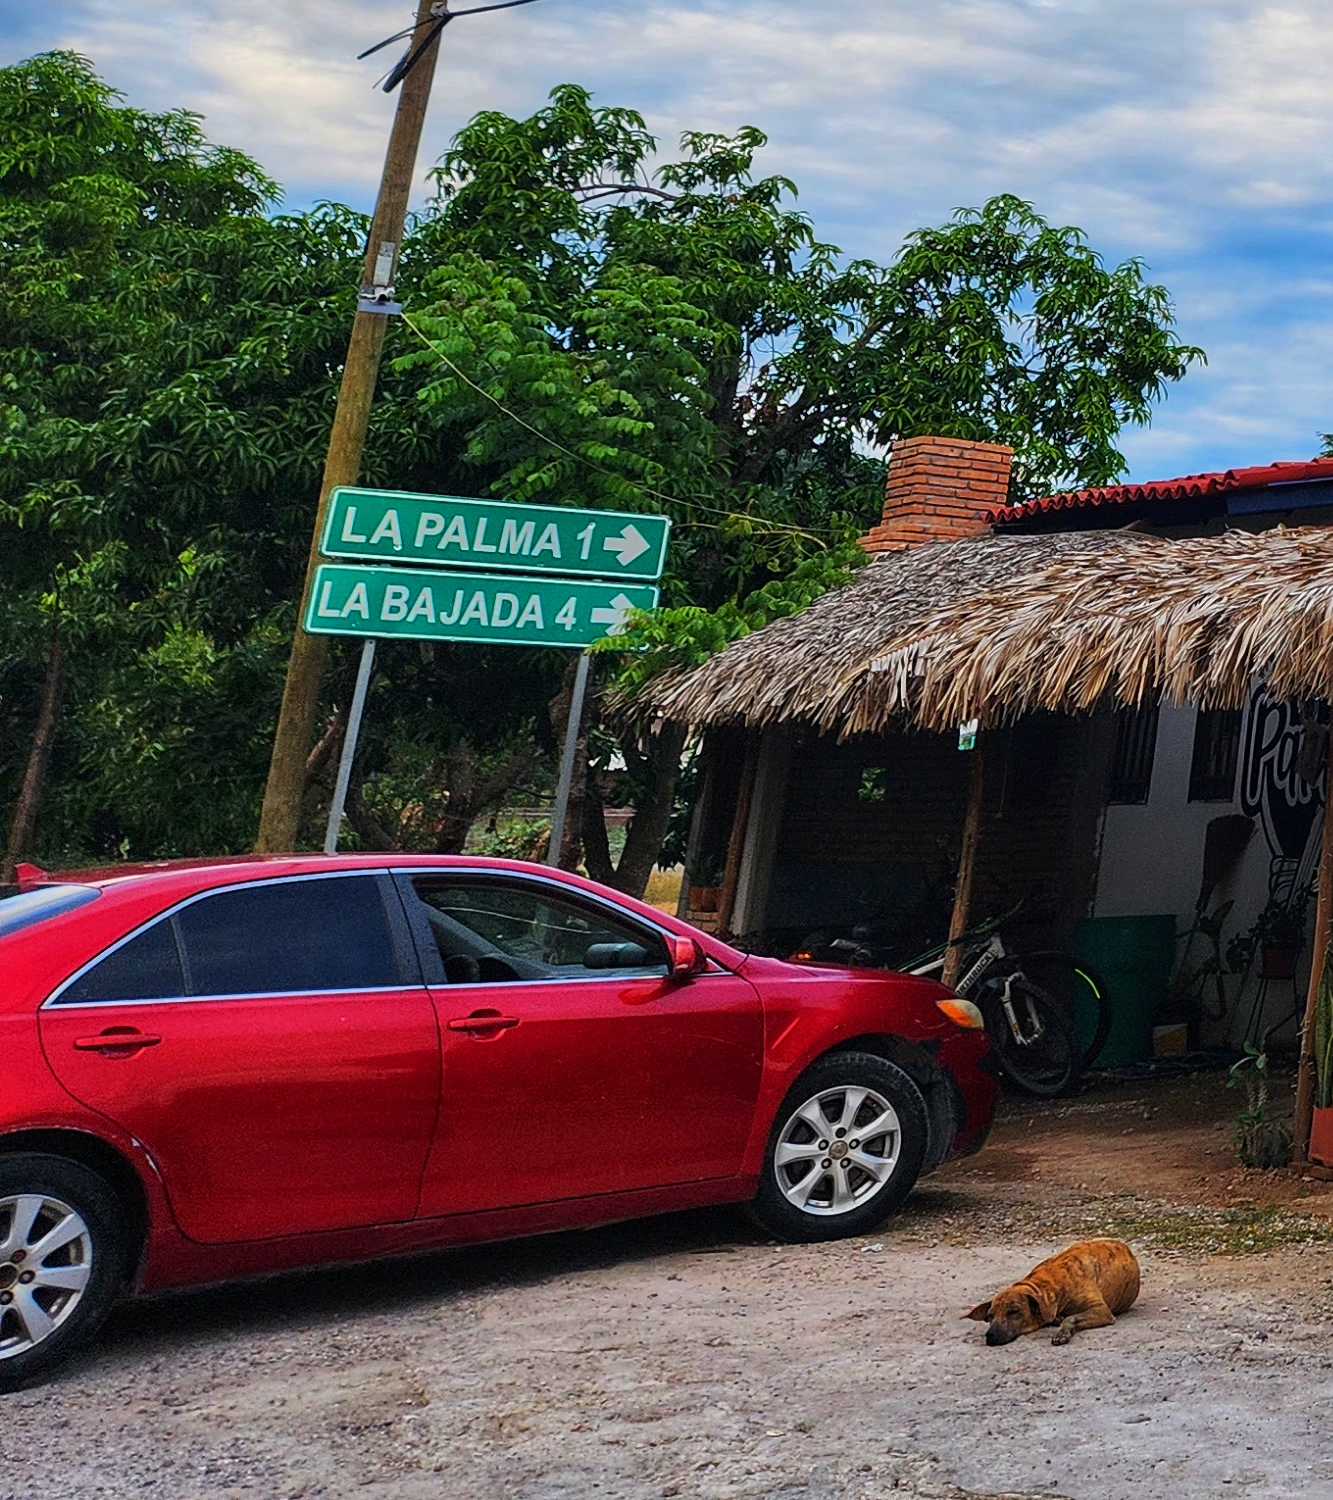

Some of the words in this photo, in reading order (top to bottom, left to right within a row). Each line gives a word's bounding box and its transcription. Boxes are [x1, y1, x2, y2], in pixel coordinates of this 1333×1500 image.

[341, 506, 403, 549] LA
[414, 512, 562, 559] PALMA
[575, 521, 597, 560] 1
[317, 580, 370, 619] LA
[380, 584, 544, 630] BAJADA
[554, 596, 577, 631] 4
